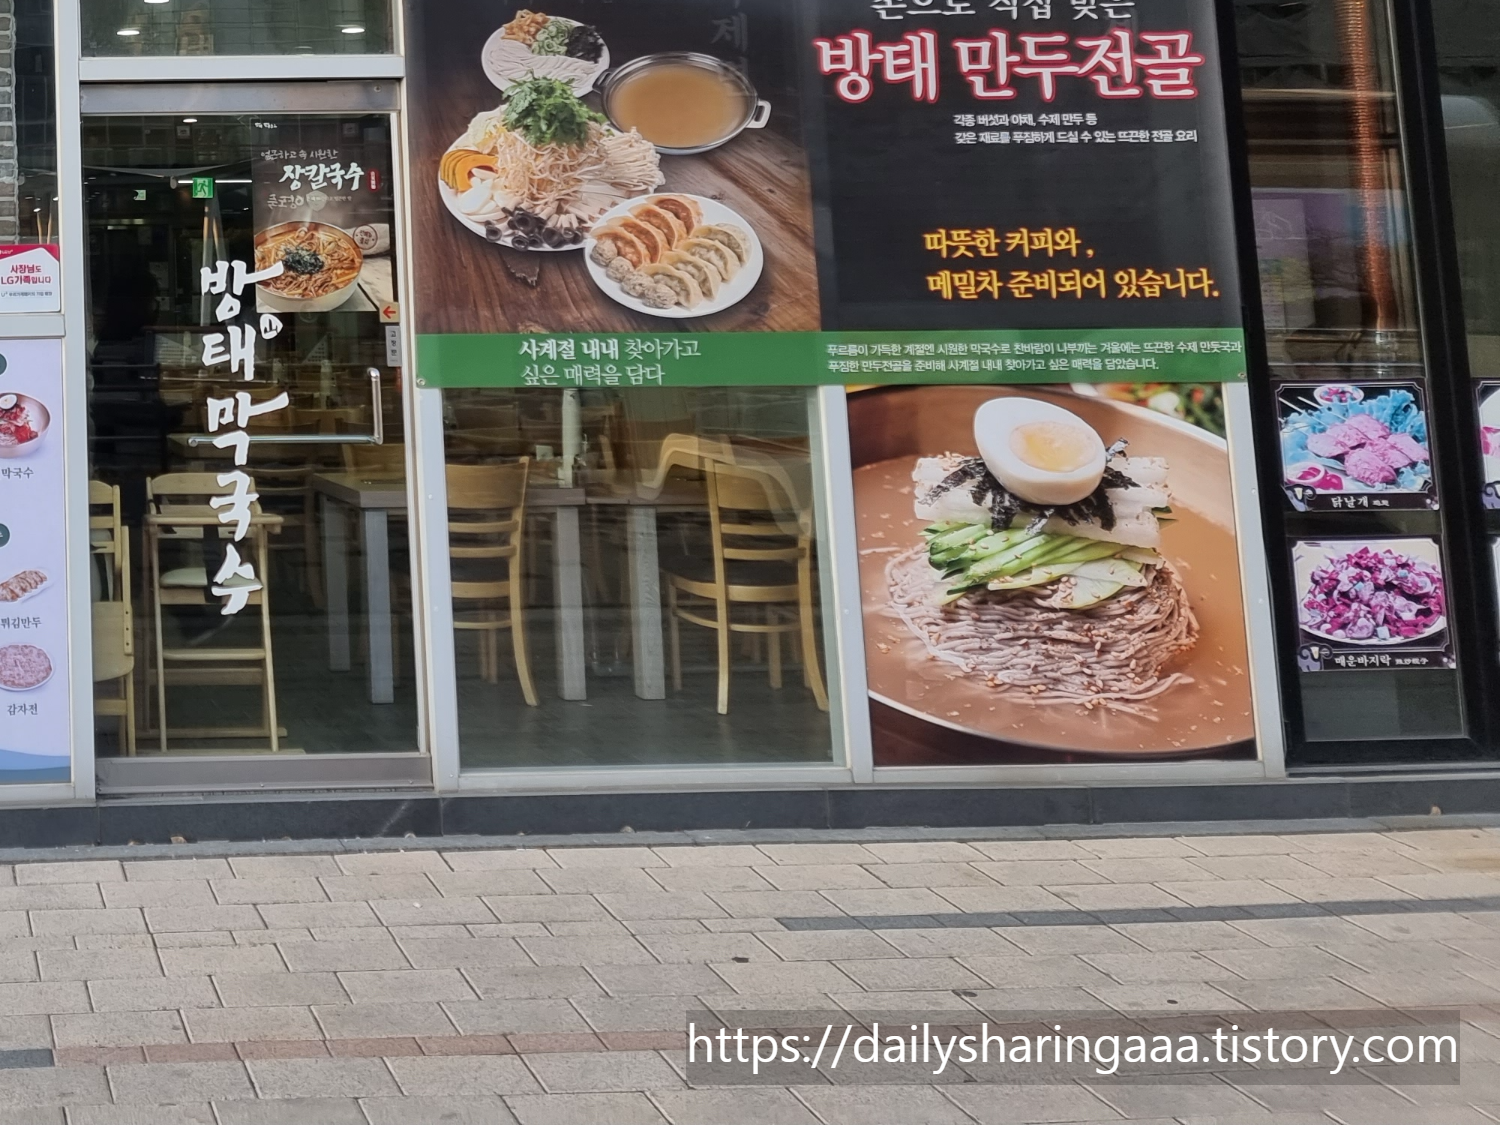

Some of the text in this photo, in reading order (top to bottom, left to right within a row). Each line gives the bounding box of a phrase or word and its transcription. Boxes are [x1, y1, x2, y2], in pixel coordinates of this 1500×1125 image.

[814, 29, 1203, 103] 방태 만두전골
[953, 114, 976, 126] 각종
[978, 114, 1009, 126] 버섯과
[1037, 113, 1061, 126] 수제
[1062, 114, 1084, 125] 만두
[1085, 113, 1098, 125] 등
[955, 129, 1198, 144] 갖은 재료를 푸짐하게 드실 수 있는 뜨끈한 전골 요리
[279, 162, 364, 191] 장칼국수
[923, 227, 1000, 258] 따뜻한
[10, 264, 42, 274] 사장님도
[928, 268, 1220, 300] 메밀차 준비되어 있습니다.
[518, 338, 702, 361] 사계절 내내 찾아가고
[827, 344, 868, 356] 푸르름이
[870, 344, 901, 355] 가득한
[904, 343, 935, 355] 계절엔
[937, 343, 968, 355] 시원한
[971, 343, 1011, 355] 막국수로
[1014, 343, 1054, 355] 찬바람이
[1057, 342, 1097, 354] 나부끼는
[1101, 342, 1141, 354] 겨울에는
[1143, 342, 1174, 353] 뜨끈한
[1176, 342, 1198, 353] 수제
[828, 358, 1159, 372] 푸짐한 만두전골을 준비해 사계절 내내 찾아가고 싶은 매력을 담았습니다.
[521, 364, 665, 386] 싶은 매력을 담다
[1331, 496, 1368, 508] 닭날개
[0, 616, 42, 629] 튀김만두
[1334, 654, 1391, 667] 매운바지락
[7, 703, 38, 716] 감자전
